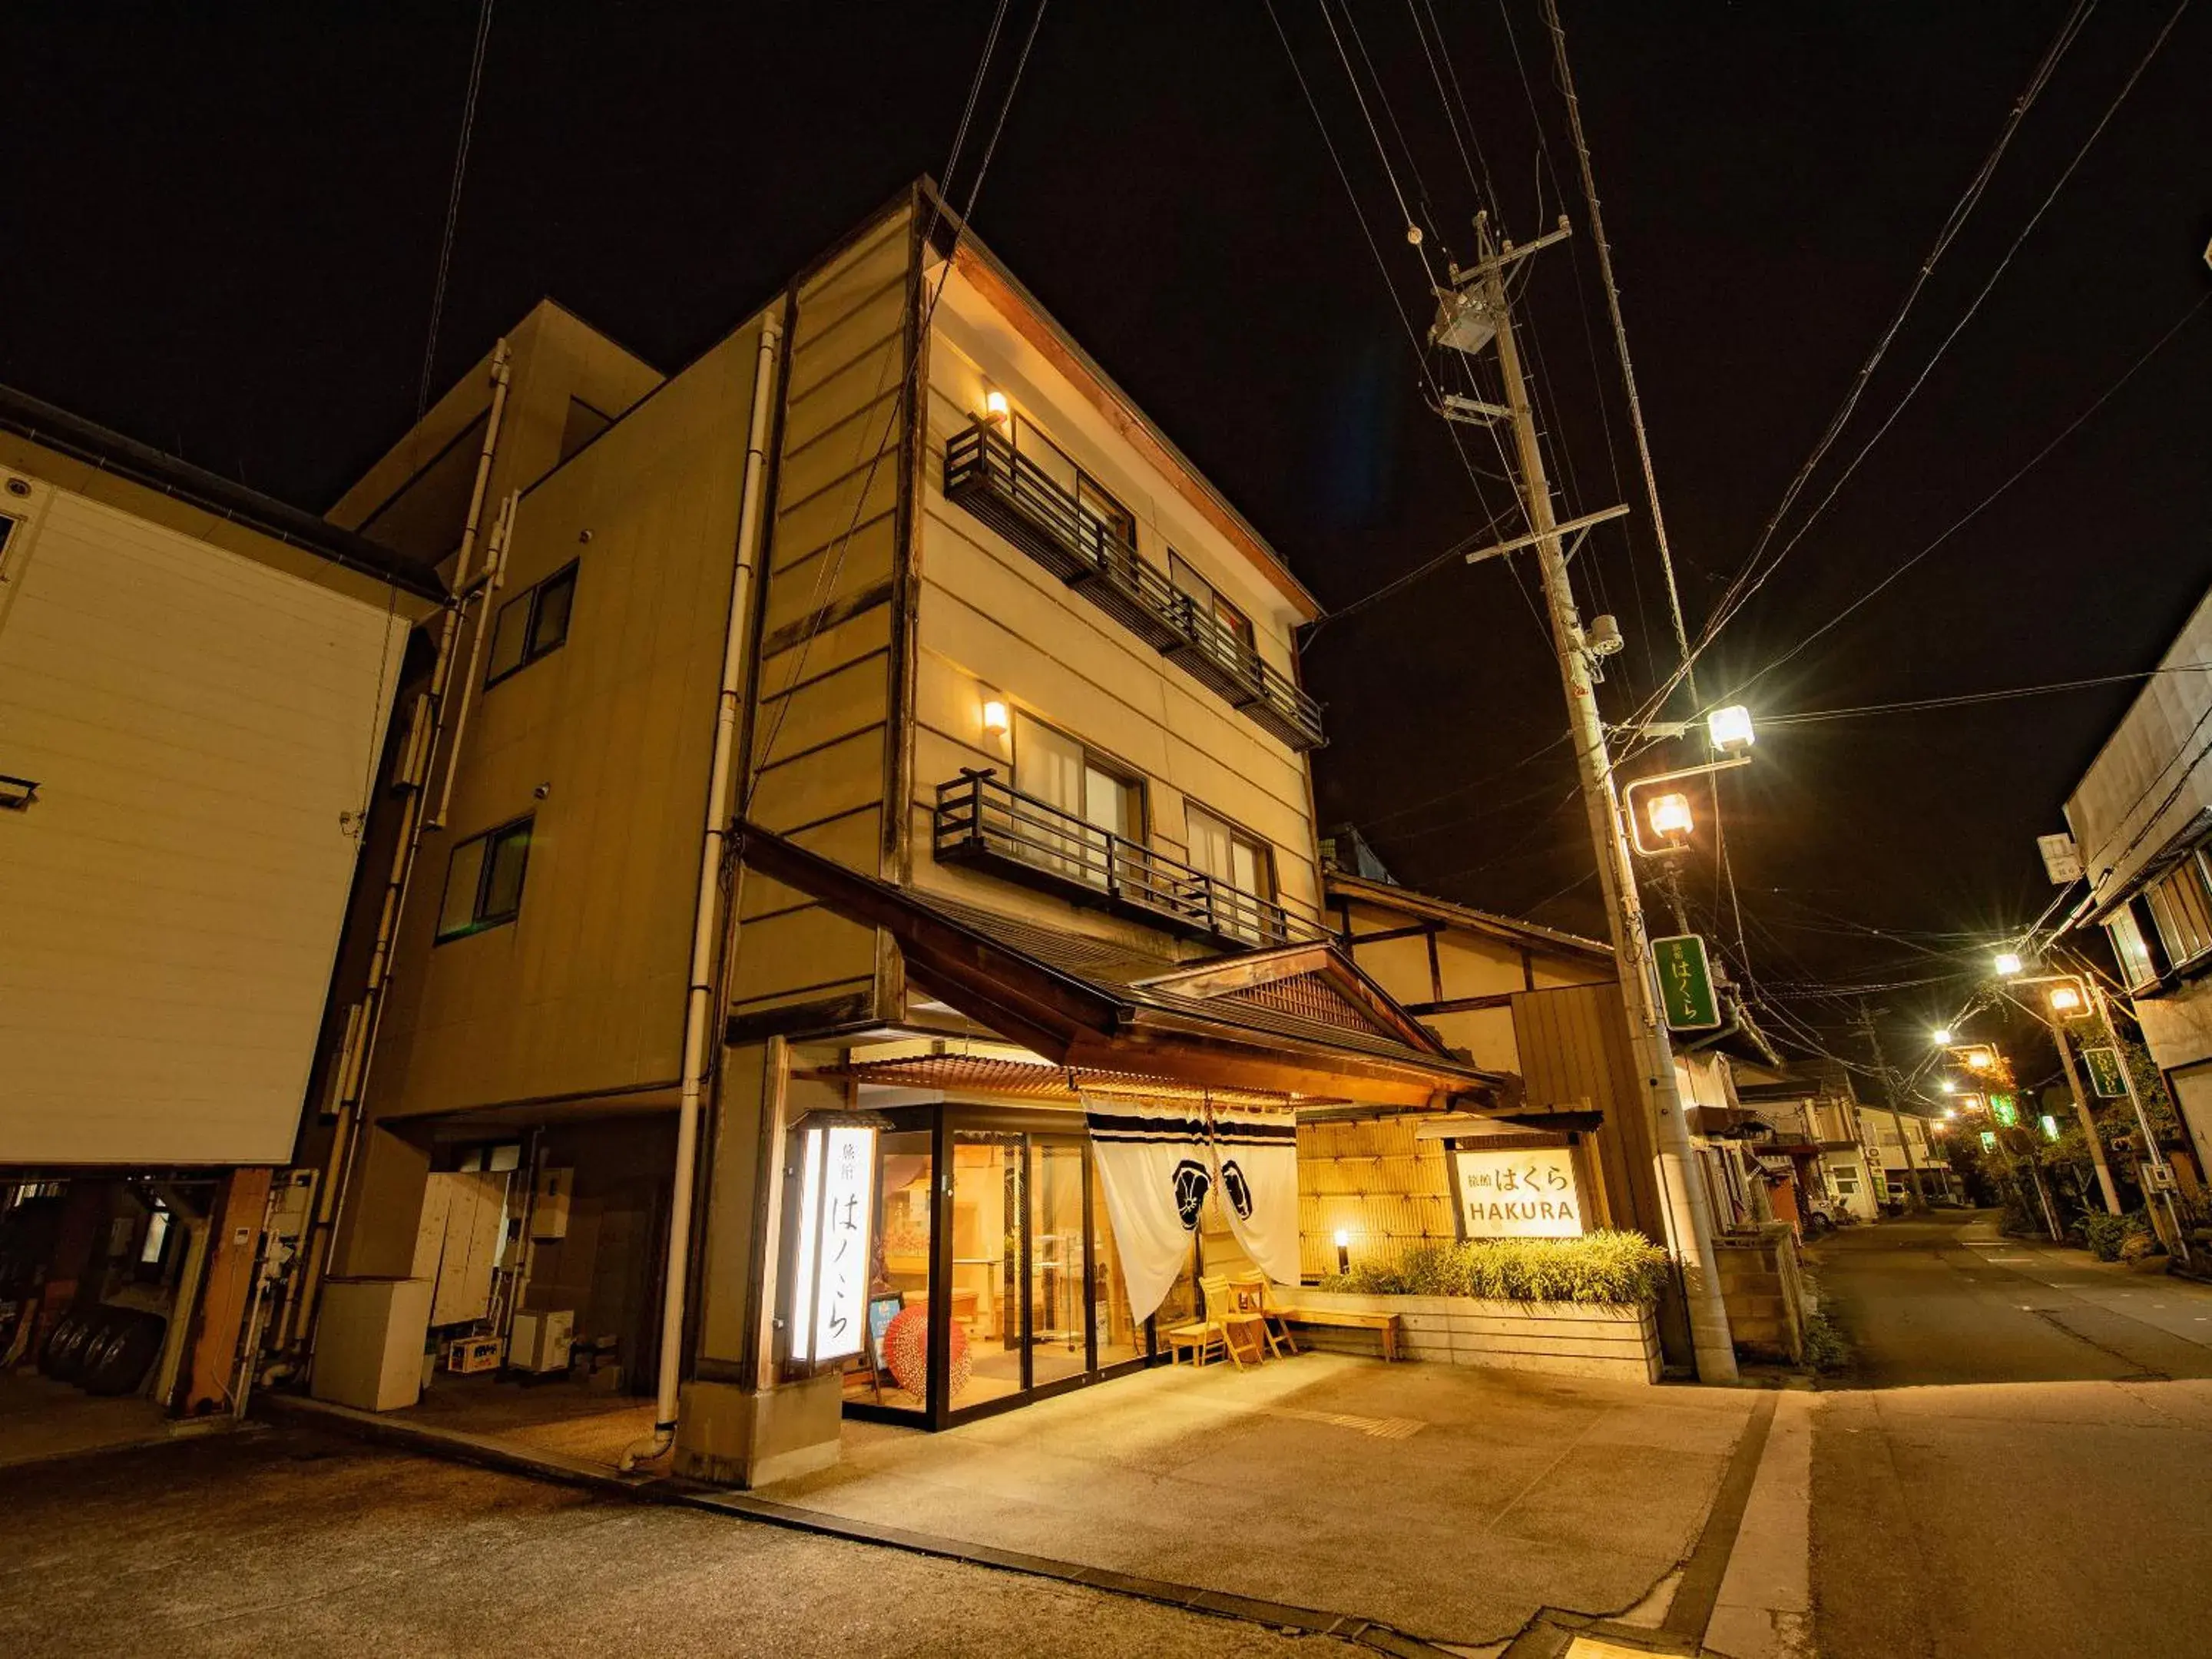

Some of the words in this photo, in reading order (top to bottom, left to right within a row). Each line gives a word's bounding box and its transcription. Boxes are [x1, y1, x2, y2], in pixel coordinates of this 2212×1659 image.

[1672, 961, 1697, 1020] はくら
[1495, 1165, 1568, 1192] はくら
[1470, 1200, 1575, 1220] HAKURA
